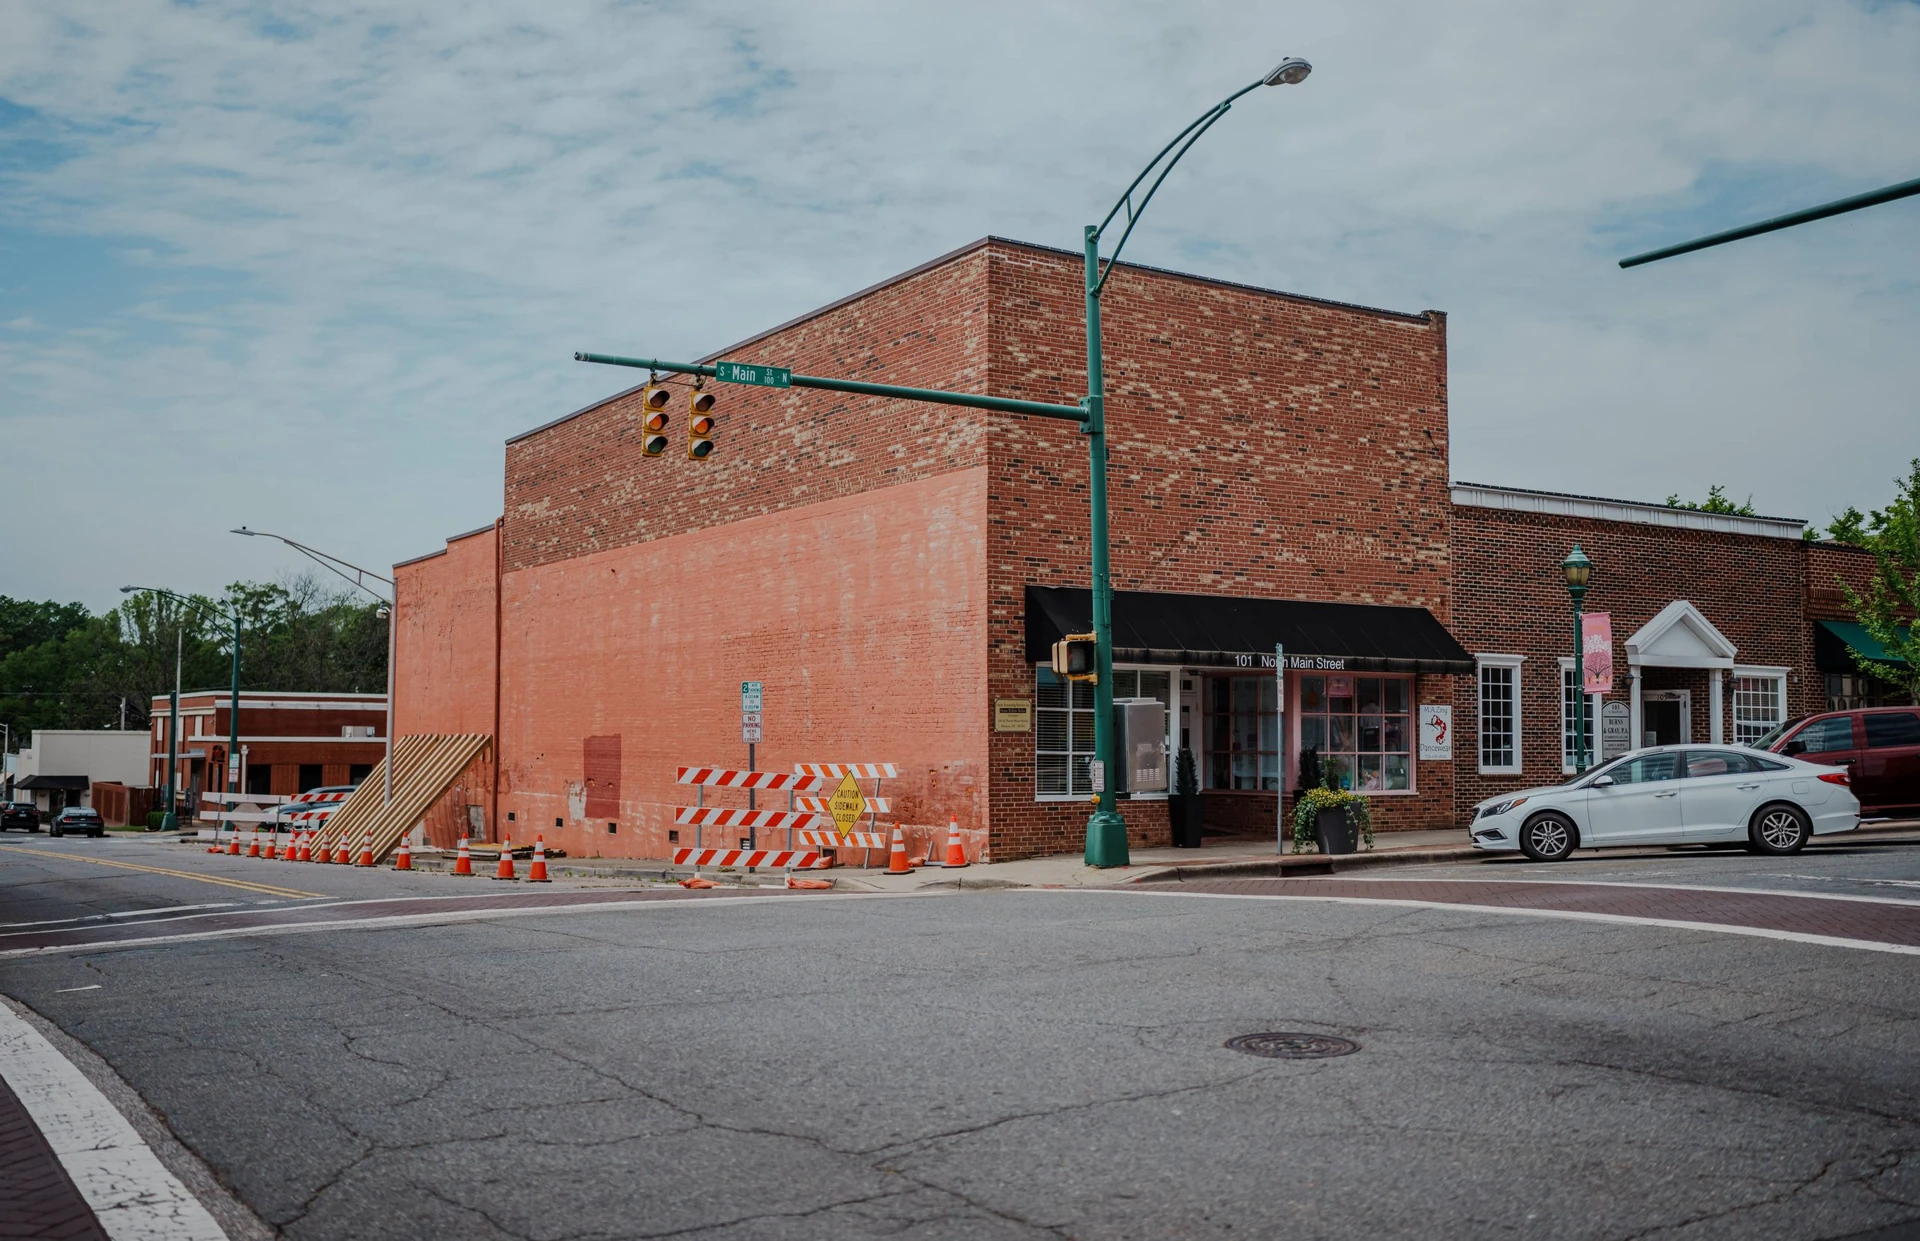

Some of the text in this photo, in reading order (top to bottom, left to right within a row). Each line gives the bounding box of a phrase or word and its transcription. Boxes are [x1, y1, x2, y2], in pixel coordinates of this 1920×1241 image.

[719, 365, 788, 383] S Main St N
[764, 376, 775, 385] 100
[1235, 655, 1345, 670] 101 Noh Main Street
[742, 683, 748, 692] 2
[1420, 743, 1452, 752] Dancewear
[836, 789, 859, 799] CAUTION
[835, 801, 859, 811] SIDEWALK
[836, 813, 856, 823] CLOSED
